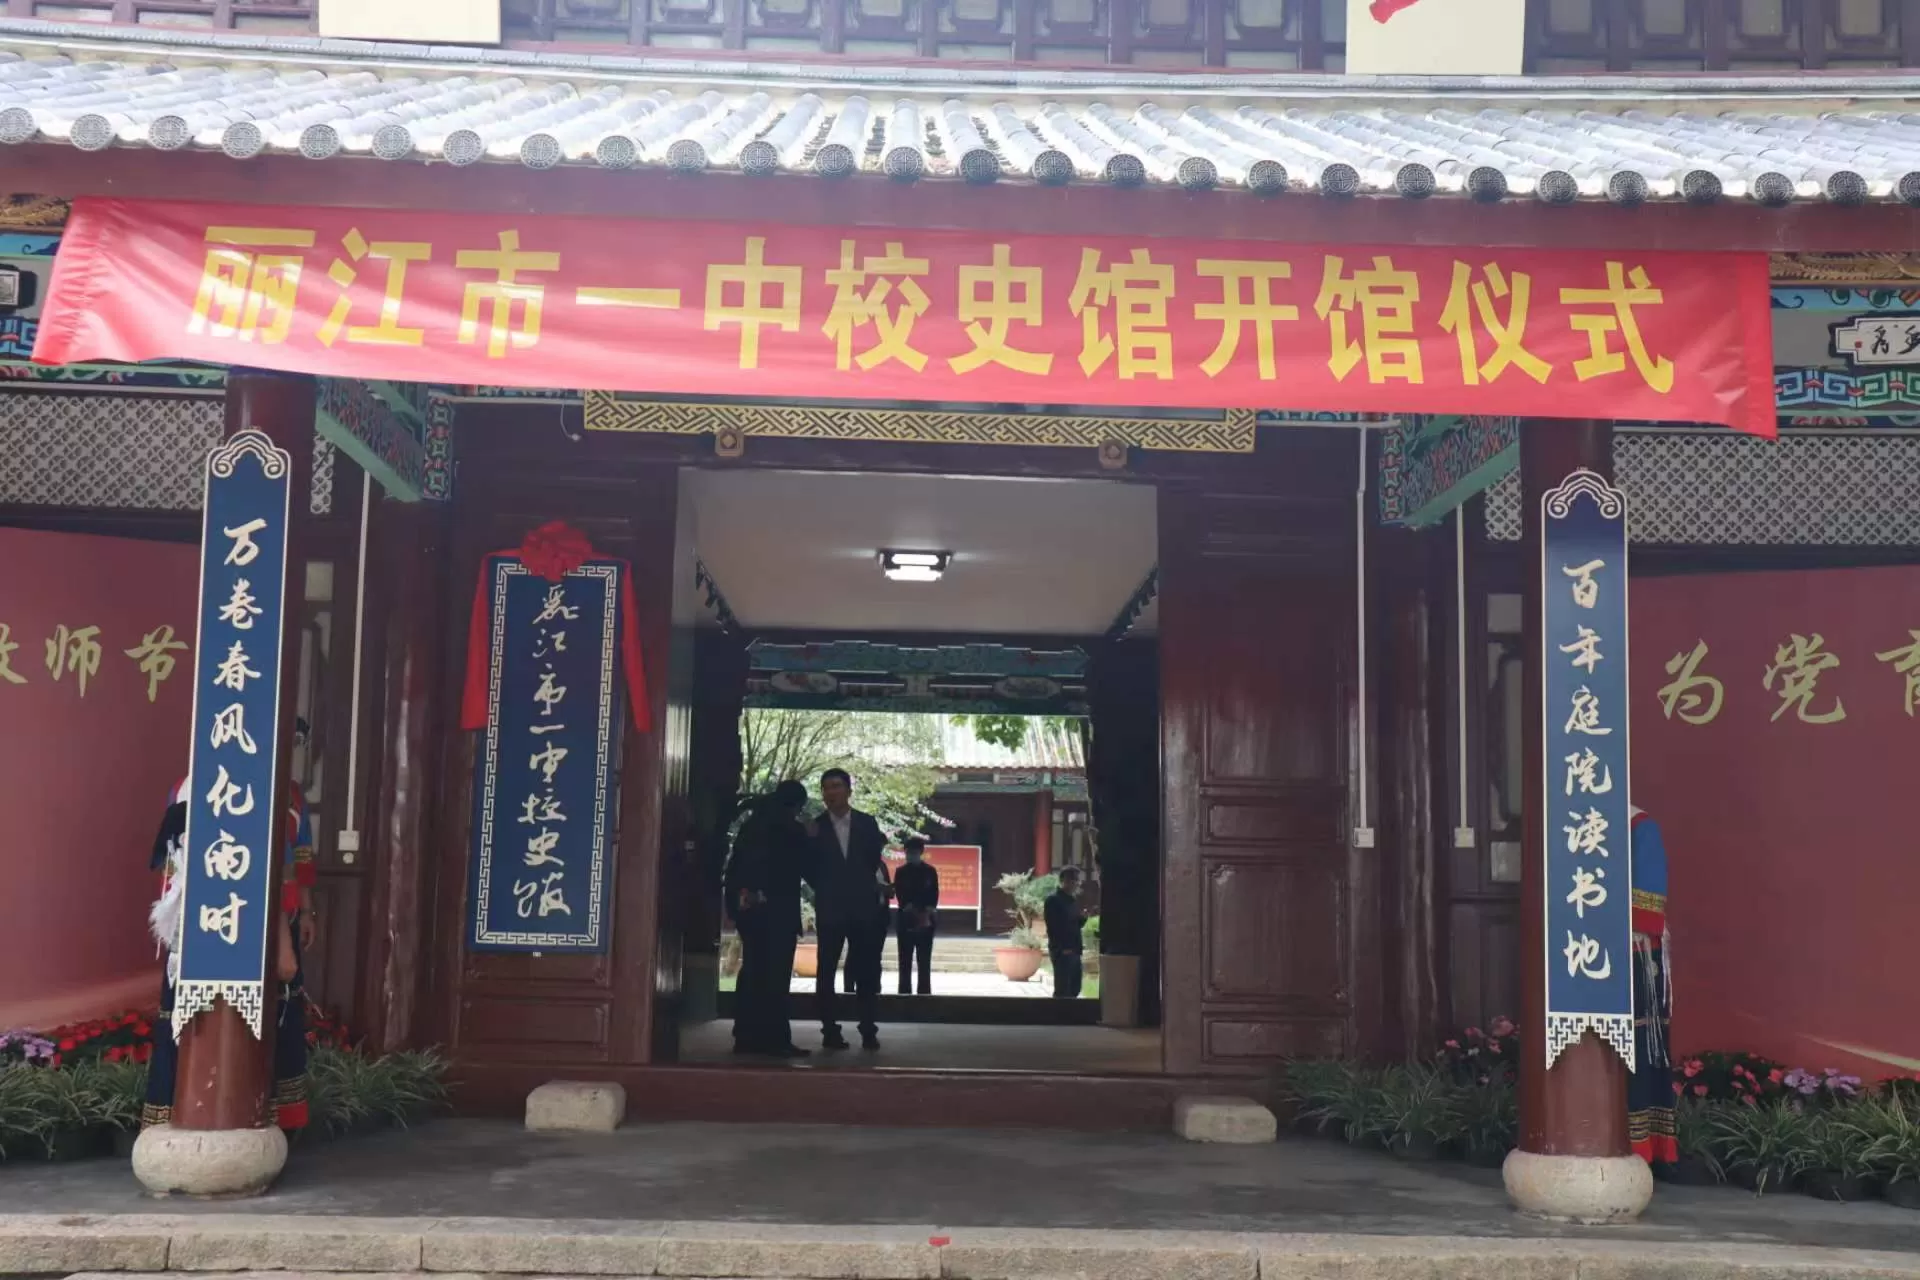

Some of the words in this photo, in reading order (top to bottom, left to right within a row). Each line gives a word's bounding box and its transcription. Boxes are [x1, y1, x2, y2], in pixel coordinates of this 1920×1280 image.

[187, 227, 1674, 393] 丽江市一中校史馆开馆仪式
[200, 518, 267, 945] 万卷春风化雨时
[1559, 559, 1612, 980] 百年庭院读书地
